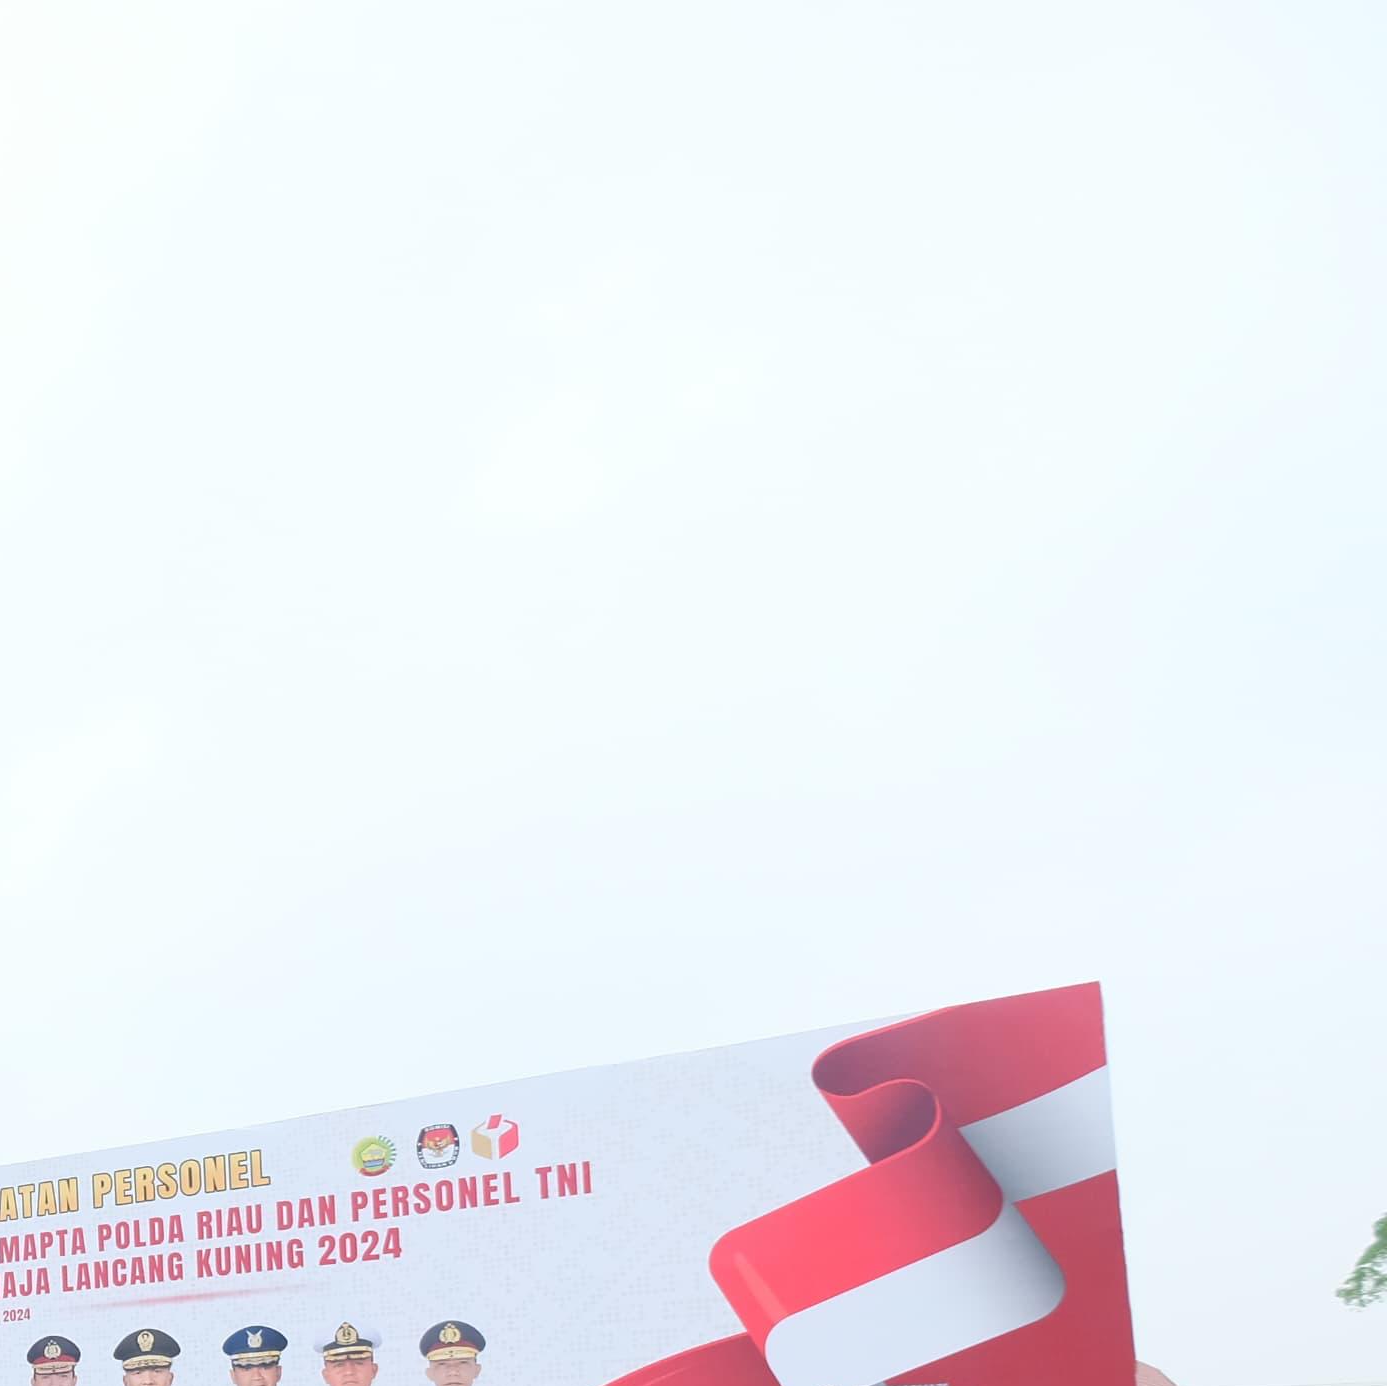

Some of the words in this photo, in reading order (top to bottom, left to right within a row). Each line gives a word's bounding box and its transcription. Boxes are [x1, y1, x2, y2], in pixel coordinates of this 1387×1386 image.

[92, 1149, 271, 1209] PERSONEL
[97, 1214, 184, 1251] POLDA
[196, 1203, 263, 1240] RIAU
[276, 1194, 336, 1231] DAN
[350, 1171, 521, 1222] PERSONEL
[534, 1160, 593, 1199] TNI
[61, 1252, 184, 1293] LANCANG
[196, 1238, 304, 1278] KUNING
[317, 1227, 402, 1266] 2024
[3, 1308, 31, 1323] 2024
